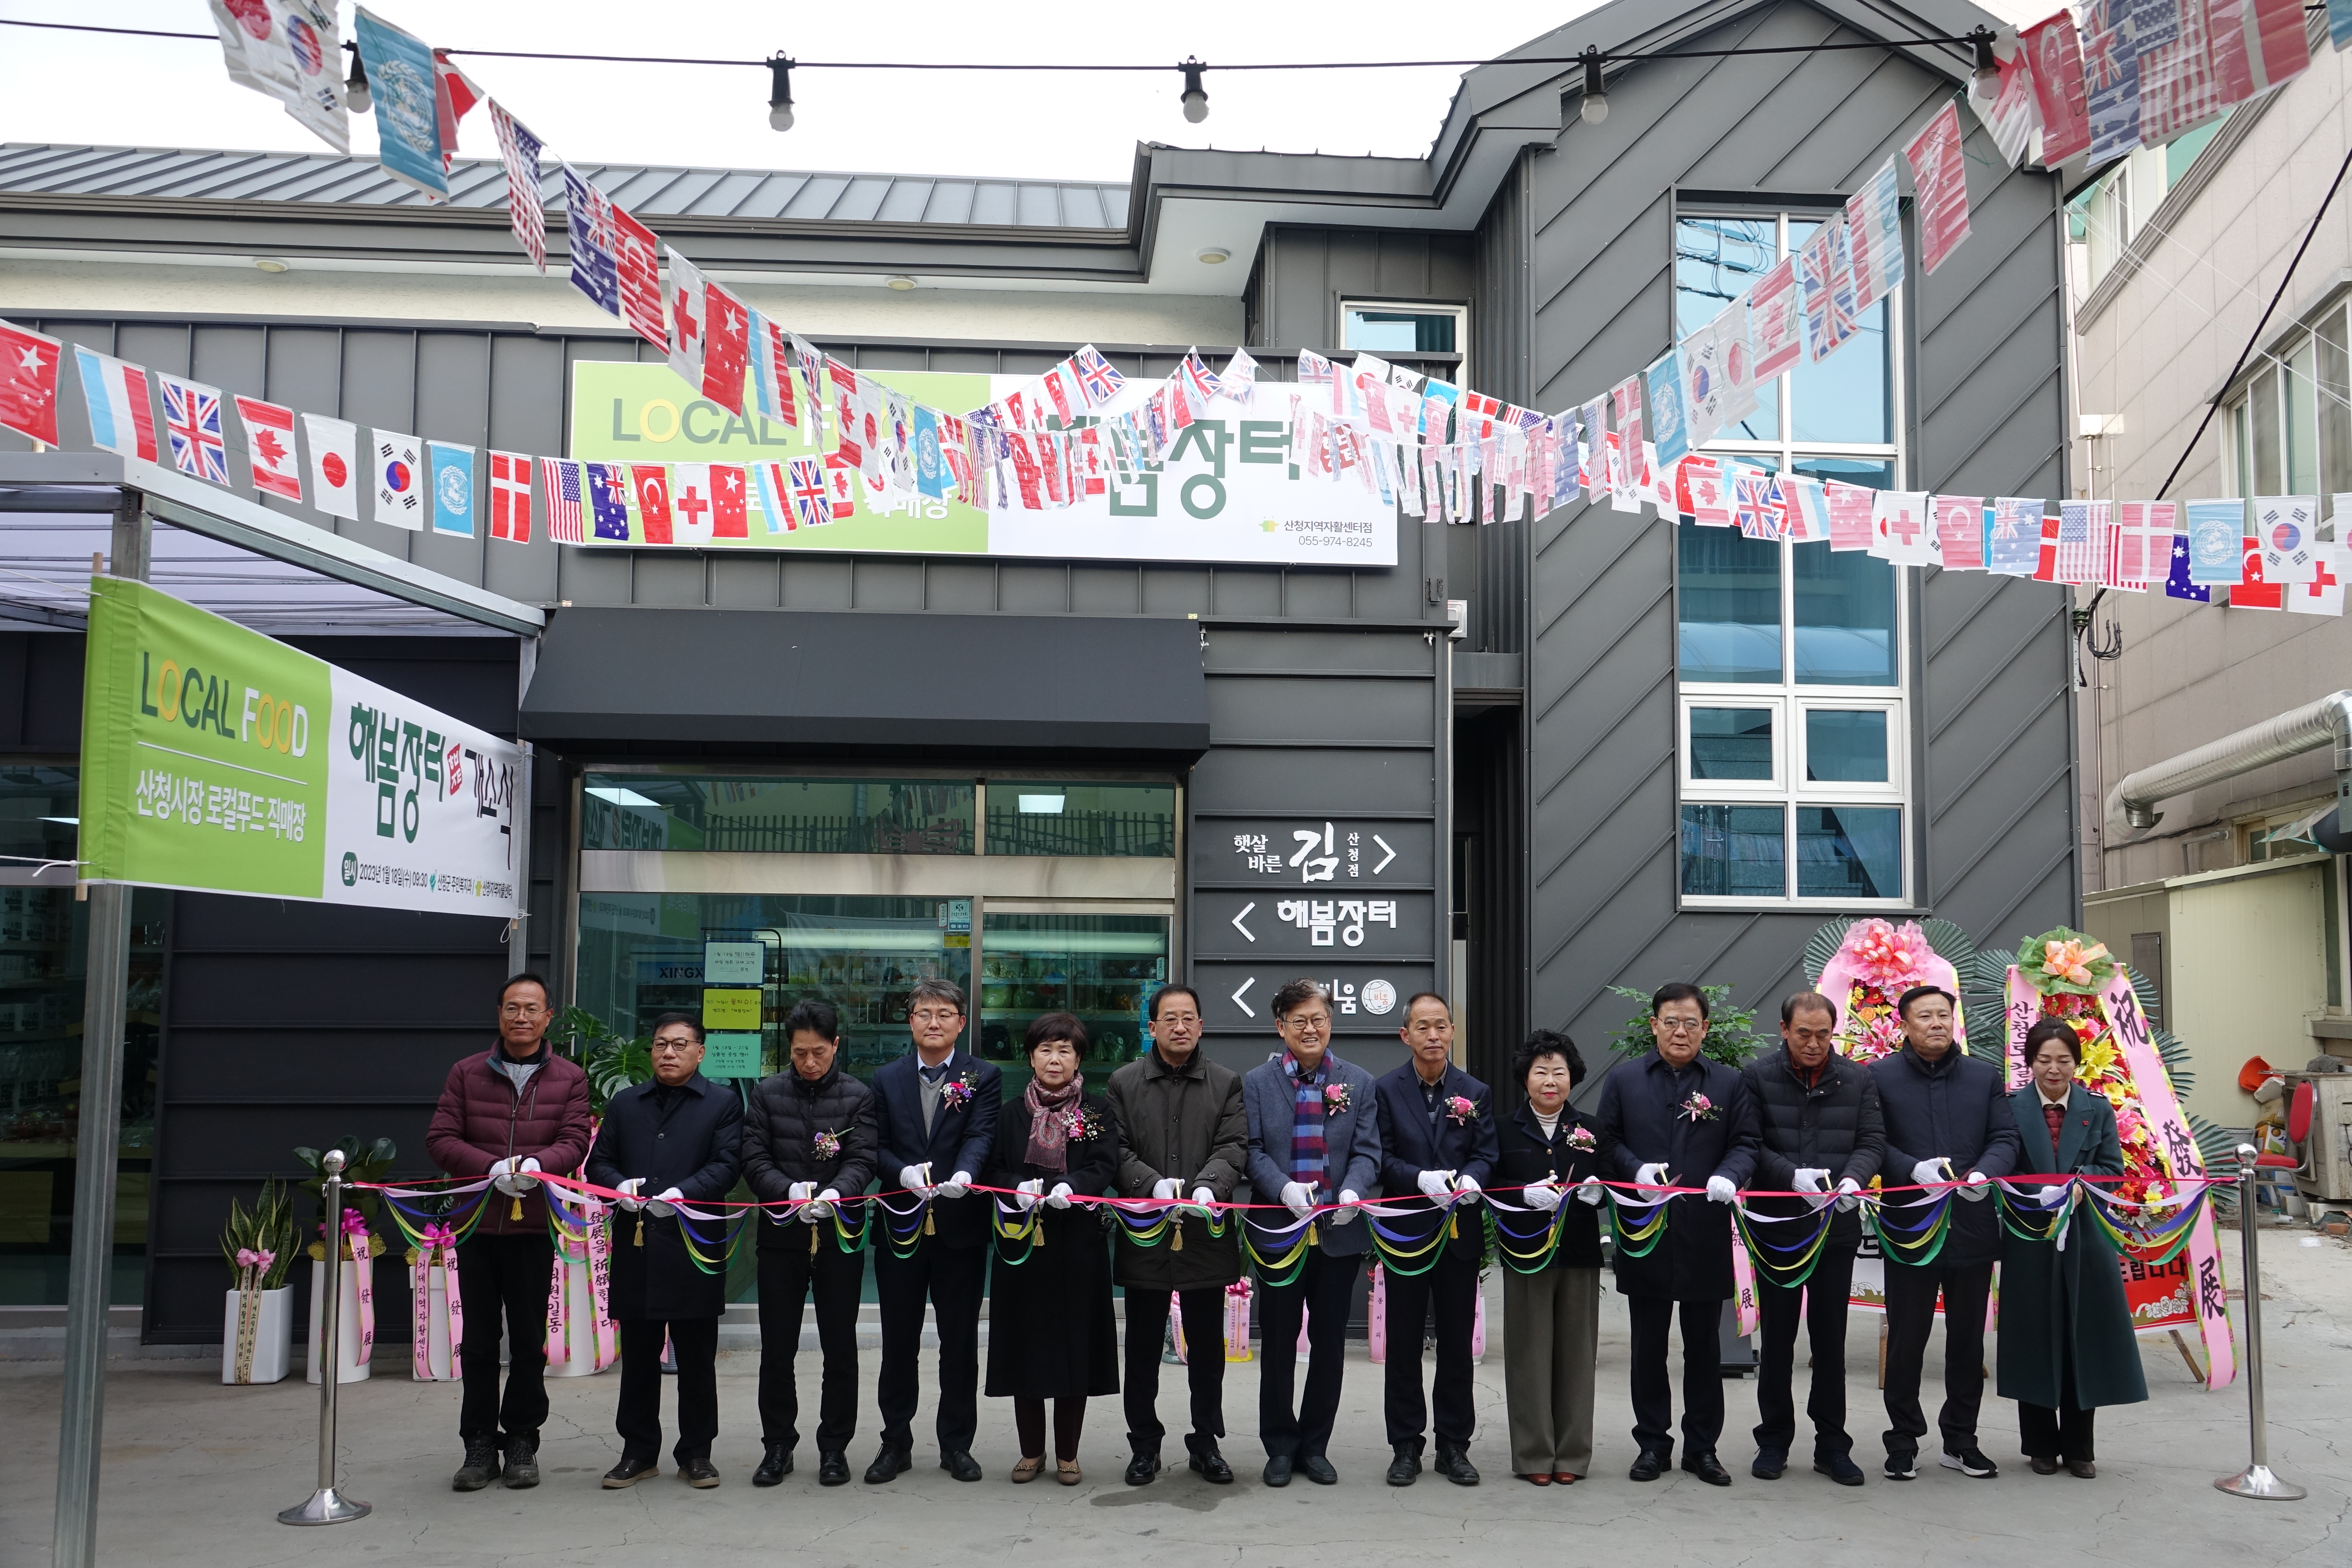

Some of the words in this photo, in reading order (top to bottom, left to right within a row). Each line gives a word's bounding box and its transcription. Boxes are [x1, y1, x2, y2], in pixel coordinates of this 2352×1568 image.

[613, 398, 787, 446] LOCAL
[1284, 521, 1372, 533] 산청지역자활센터점
[1298, 536, 1372, 547] 055-974-8245
[141, 651, 235, 739] LOCAL
[242, 686, 308, 757] FOOD
[349, 701, 447, 843] 해봄장터
[465, 748, 514, 870] 개소식
[136, 769, 205, 825] 산청시장
[206, 785, 265, 833] 로컬푸드
[267, 797, 306, 842] 직매장
[1234, 834, 1269, 854] 햇살
[1289, 821, 1340, 884] 김
[1347, 832, 1360, 878] 산청점
[344, 859, 356, 881] 일시
[359, 864, 381, 883] 2023년
[382, 865, 390, 885] 1월
[391, 867, 411, 888] 18일(수)
[413, 870, 428, 888] 09:30
[1248, 854, 1283, 873] 바른
[438, 874, 451, 892] 산청군
[451, 876, 472, 895] 주민복지과
[1277, 900, 1396, 947] 해봄장터
[1374, 992, 1388, 1005] 비움
[416, 1260, 427, 1362] 거제지역자활센터
